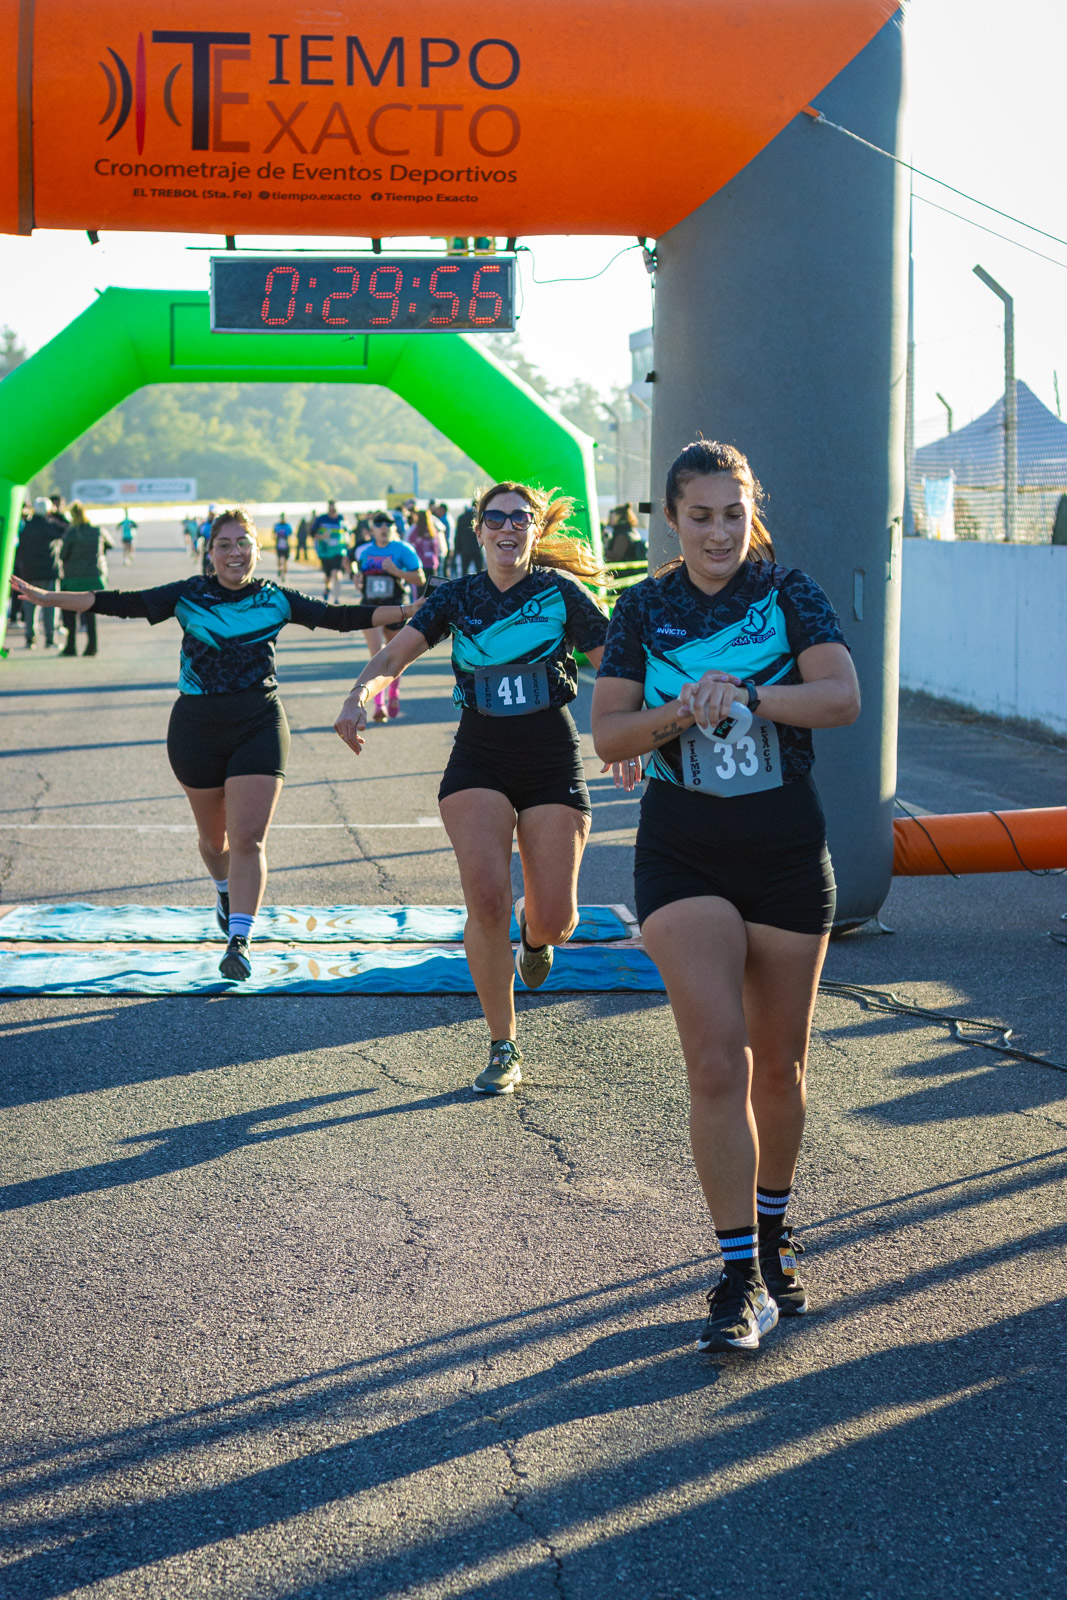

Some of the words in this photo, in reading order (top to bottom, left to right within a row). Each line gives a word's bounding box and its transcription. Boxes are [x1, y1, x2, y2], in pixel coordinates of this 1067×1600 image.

[94, 158, 250, 182] Cronometraje
[256, 161, 285, 180] de
[292, 163, 383, 181] Eventos
[390, 164, 517, 185] Deportivos
[133, 188, 147, 197] EL
[150, 188, 199, 198] TREBOL
[202, 189, 230, 199] (Sta.
[233, 190, 252, 200] Fe)
[272, 191, 361, 202] tiempo.exacto
[385, 193, 433, 203] Tiempo
[436, 194, 478, 203] Exacto
[261, 265, 503, 325] 0:29:56
[656, 627, 687, 636] INVICTO
[497, 675, 526, 706] 41
[687, 740, 702, 786] TIEMPO
[713, 736, 759, 780] 33
[760, 726, 773, 773] EXACTO
